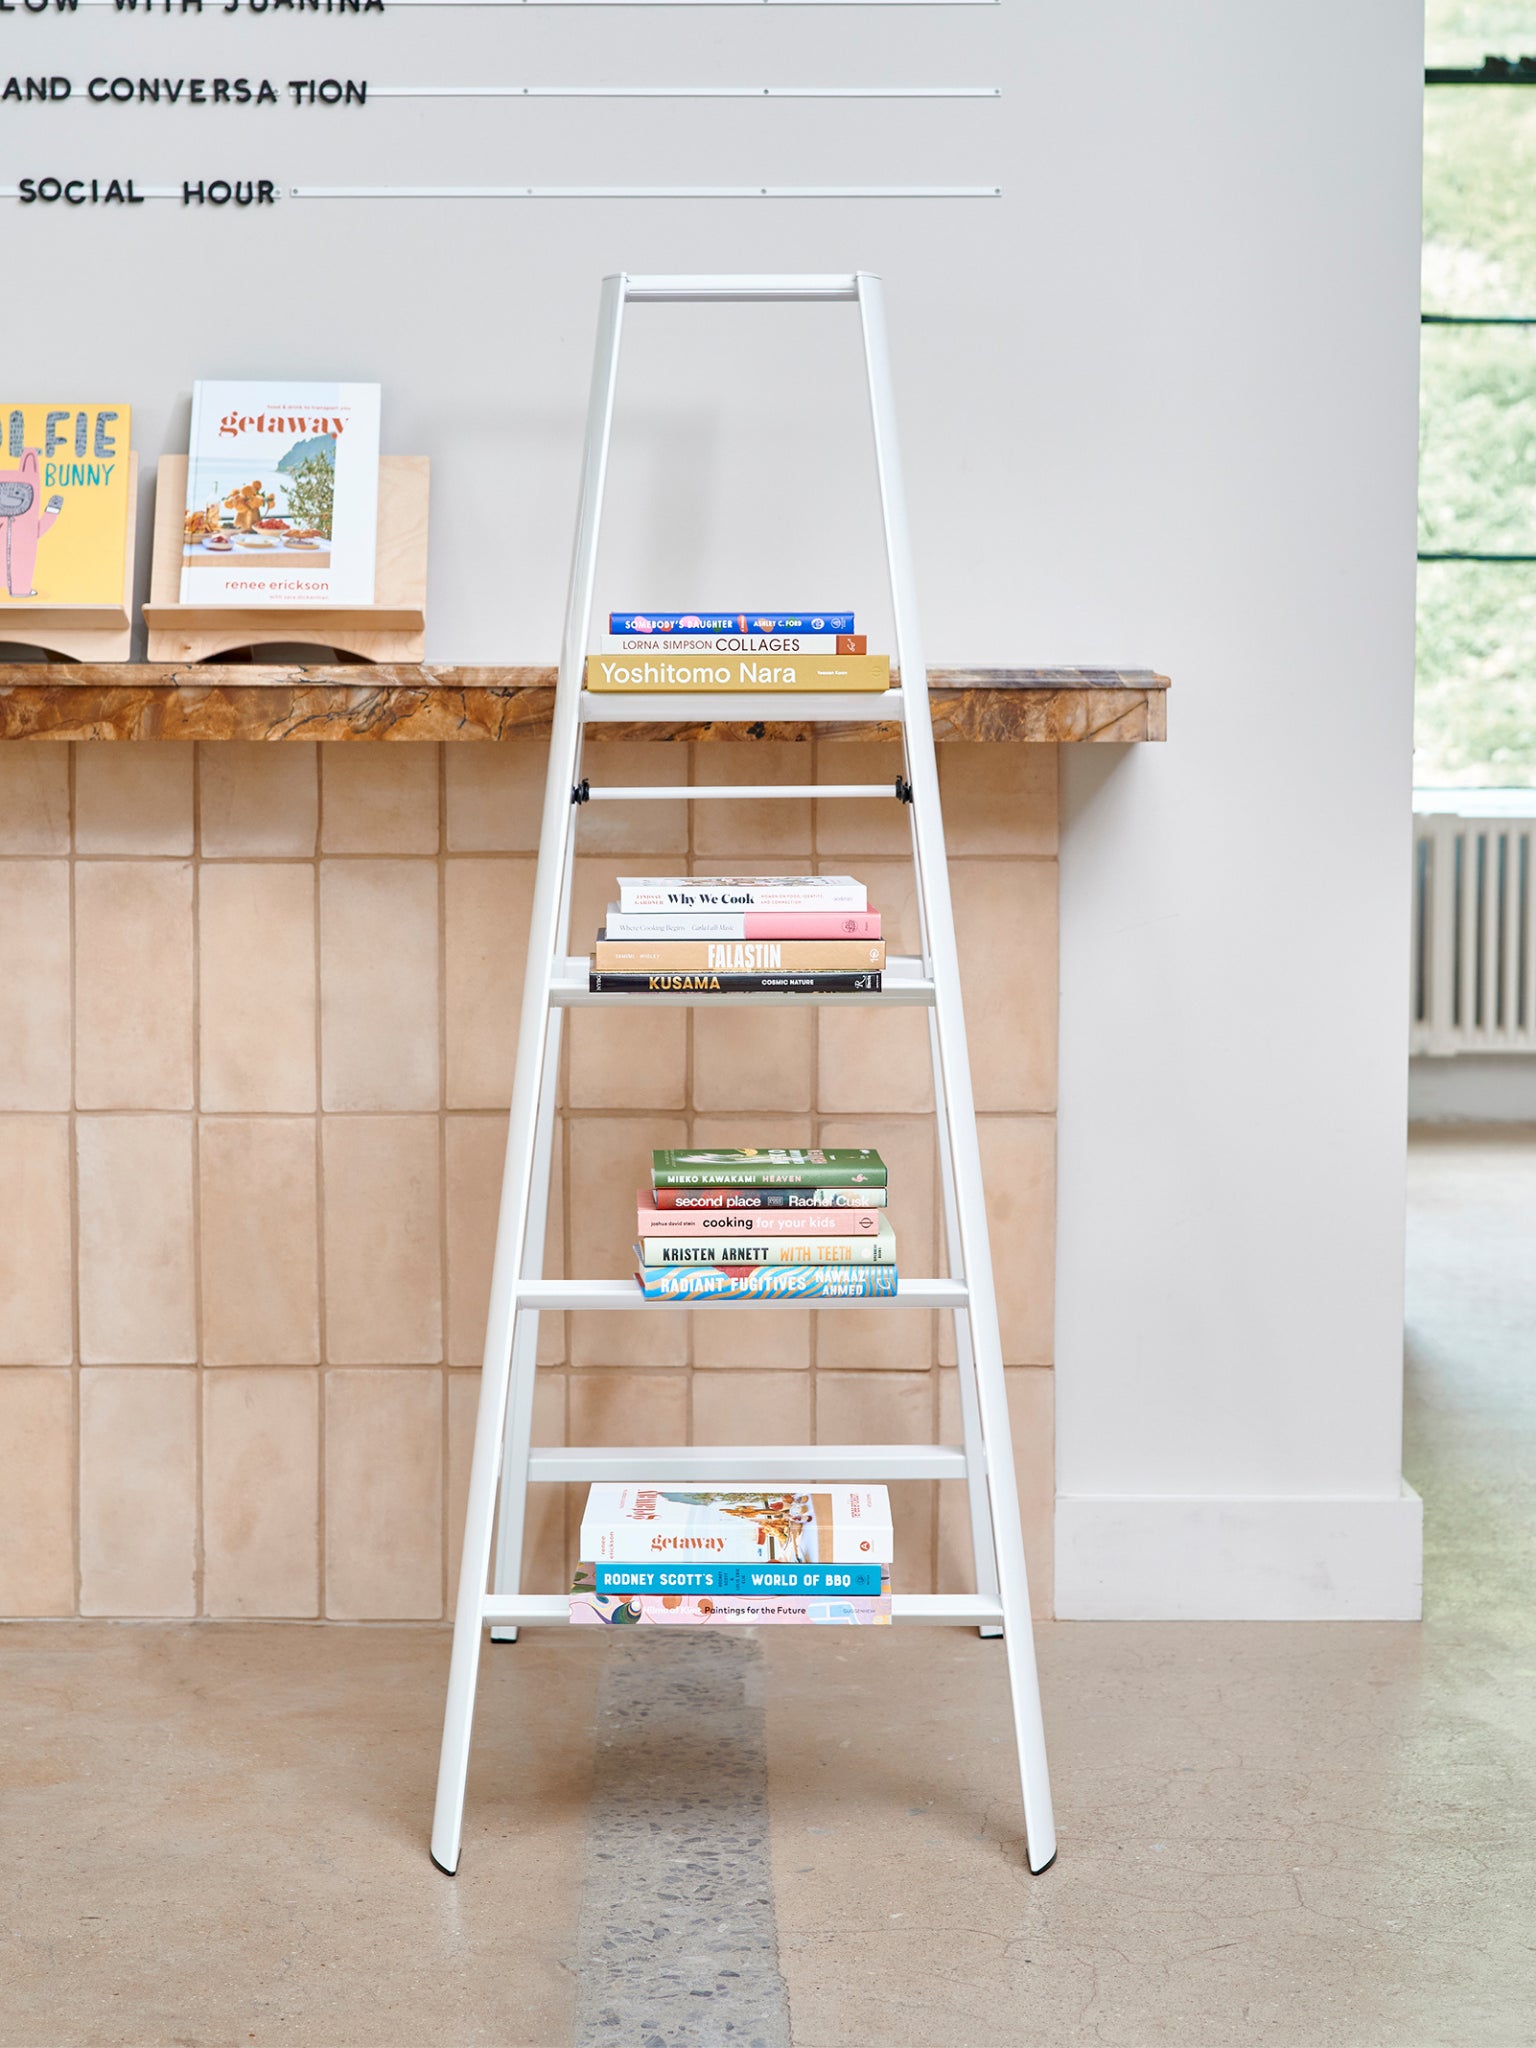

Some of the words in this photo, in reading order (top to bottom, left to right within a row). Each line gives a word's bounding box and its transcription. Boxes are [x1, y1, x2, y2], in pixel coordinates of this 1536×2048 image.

[2, 77, 72, 102] AND
[19, 177, 145, 204] SOCIAL
[182, 179, 276, 205] HOUR
[218, 411, 349, 440] getaway
[0, 409, 119, 458] LFIE
[45, 463, 115, 487] BUNNY
[225, 581, 266, 590] renee
[269, 579, 329, 591] erickson
[687, 619, 733, 629] DAUGHTER
[753, 619, 777, 627] ASHLEY
[785, 619, 802, 627] FORD
[622, 640, 660, 650] LORNA
[663, 640, 713, 650] SIMPSON
[715, 638, 800, 652] COLLAGES
[600, 662, 731, 684] Yoshitomo
[739, 662, 796, 684] Nara
[668, 893, 697, 907] Why
[699, 893, 719, 904] We
[721, 893, 755, 904] Cook
[708, 944, 782, 969] FALASTIN
[649, 976, 721, 990] KUSAMA
[667, 1175, 699, 1183] MIEKO
[702, 1175, 756, 1183] KAWAKAMI
[762, 1175, 802, 1183] HEAVEN
[675, 1195, 723, 1207] second
[726, 1195, 761, 1208] place
[788, 1194, 833, 1207] Rachel
[836, 1194, 870, 1207] Cusk
[703, 1217, 753, 1230] cooking
[756, 1216, 775, 1228] for
[778, 1219, 806, 1230] your
[809, 1216, 836, 1228] kids
[663, 1248, 715, 1261] KRISTEN
[721, 1247, 769, 1261] ARNETT
[780, 1247, 811, 1261] WITH
[817, 1246, 852, 1261] TEETH
[815, 1269, 866, 1283] NAWAAZ
[660, 1277, 725, 1293] RADIANT
[731, 1276, 807, 1292] FUGITIVES
[822, 1284, 864, 1296] AHMED
[651, 1534, 727, 1552] getaway
[604, 1573, 654, 1585] RODNEY
[751, 1574, 798, 1586] WORLD
[803, 1574, 820, 1586] OF
[825, 1574, 852, 1587] BBQ
[704, 1606, 745, 1616] Paintings
[746, 1606, 760, 1614] for
[761, 1606, 776, 1614] the
[777, 1606, 806, 1614] Future
